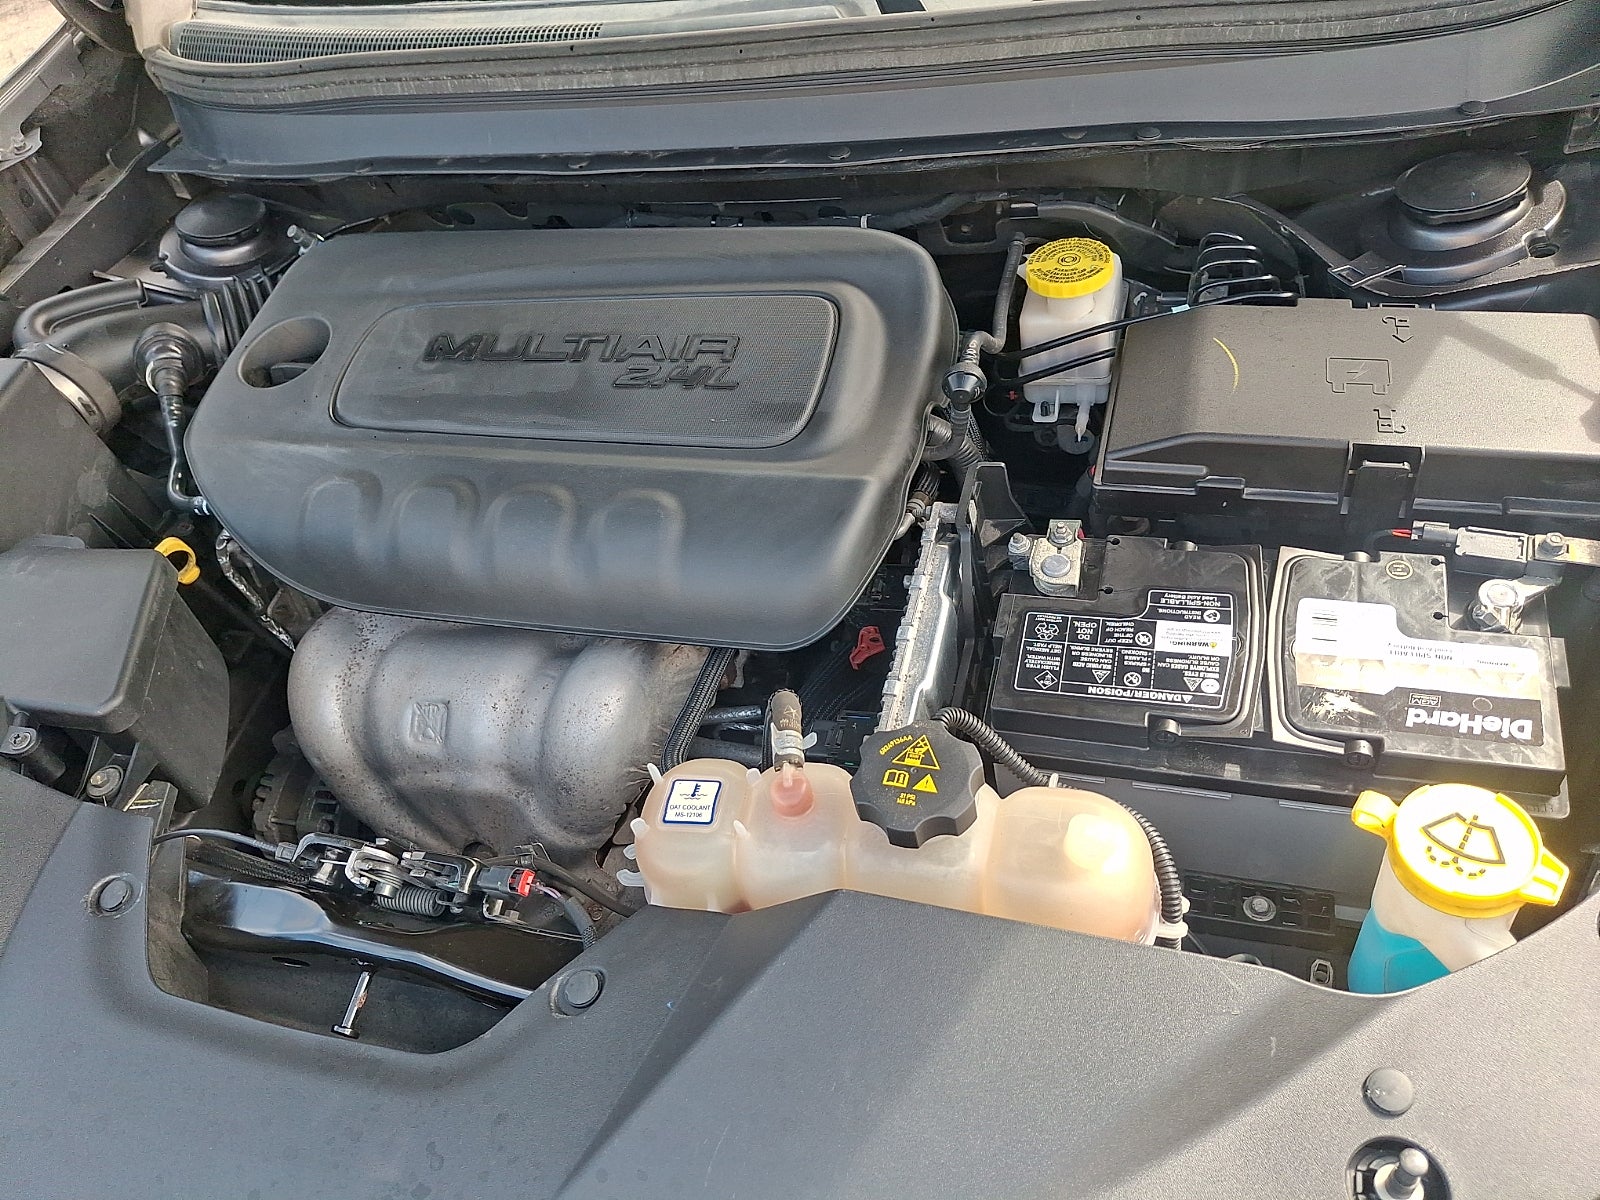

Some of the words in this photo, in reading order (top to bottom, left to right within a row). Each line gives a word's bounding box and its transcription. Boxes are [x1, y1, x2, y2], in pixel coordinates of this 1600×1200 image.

[423, 332, 741, 362] MULTIAIR
[612, 365, 740, 389] 2.4L
[1160, 598, 1221, 607] NON-SPILLABLE
[1087, 686, 1182, 702] DANGER/POISON
[1411, 697, 1439, 706] AGM
[1405, 707, 1533, 740] DieHard
